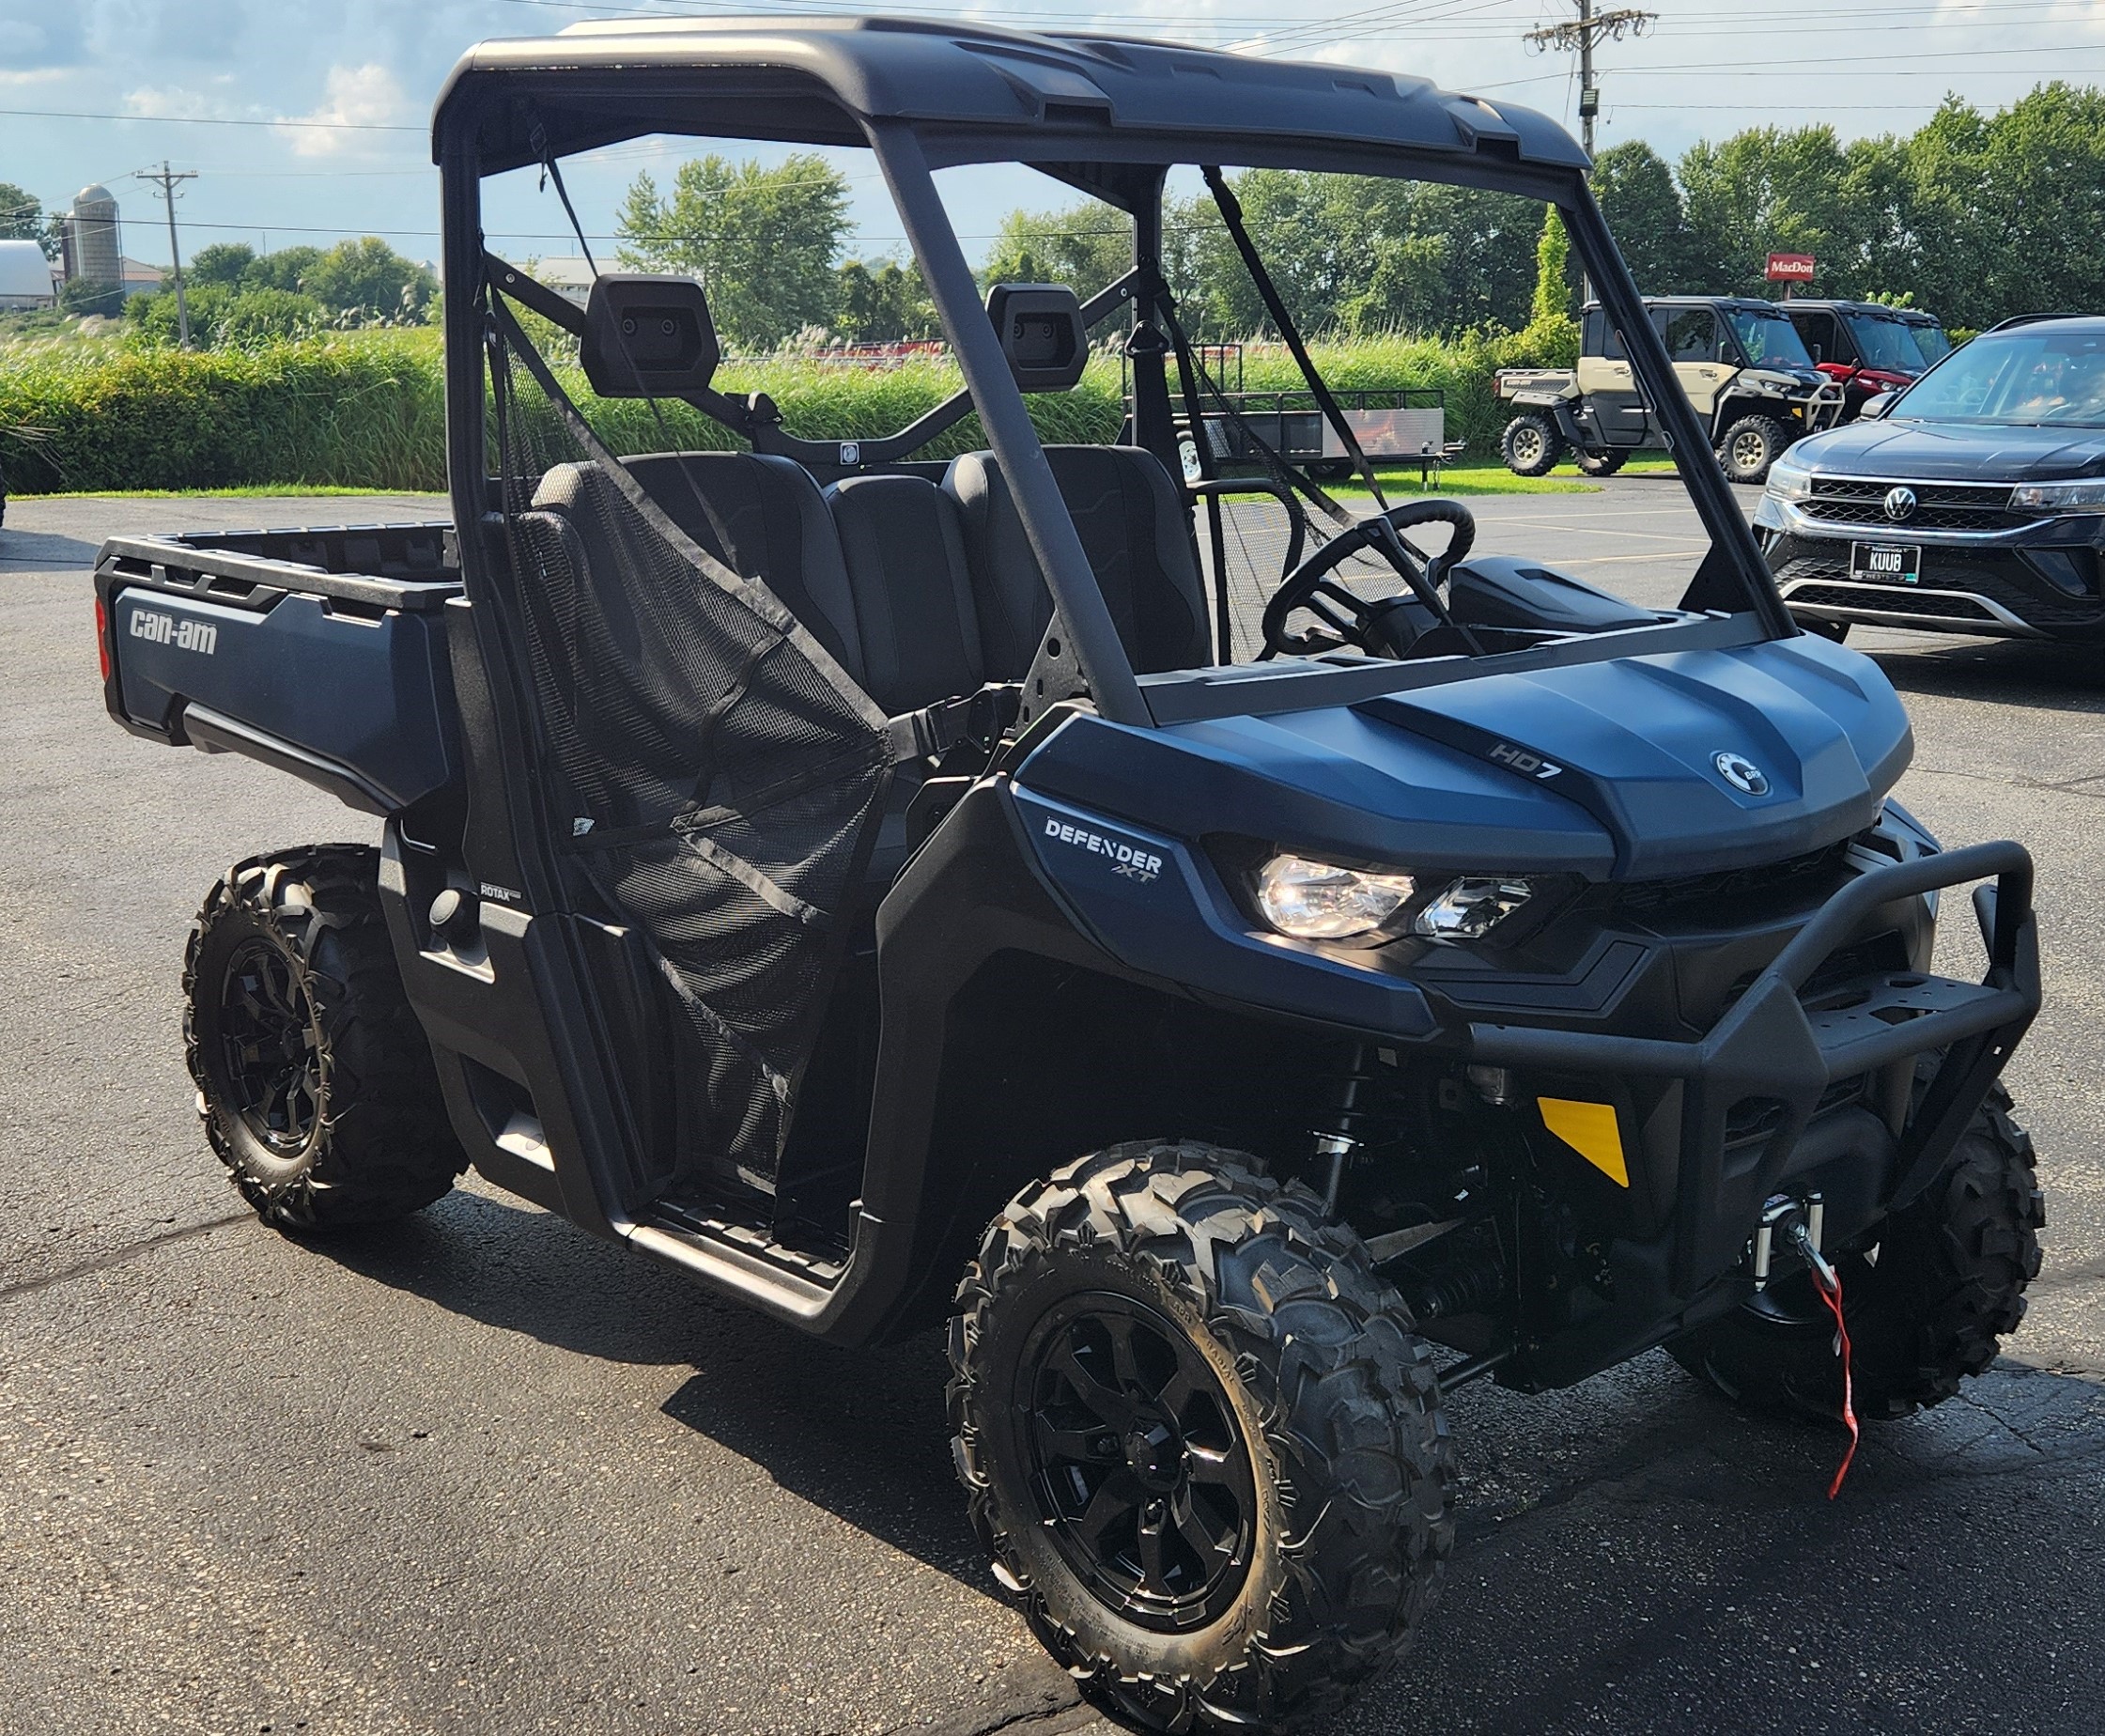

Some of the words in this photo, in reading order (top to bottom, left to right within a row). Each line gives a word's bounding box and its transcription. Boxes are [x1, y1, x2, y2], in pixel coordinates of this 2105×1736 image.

[1771, 261, 1814, 273] MacDon
[1869, 551, 1902, 572] KUUB
[130, 610, 217, 655] can-am
[1489, 743, 1562, 779] HD7
[1045, 818, 1163, 875] DEFENDER
[1110, 861, 1157, 884] XT
[480, 884, 511, 902] ROTAX
